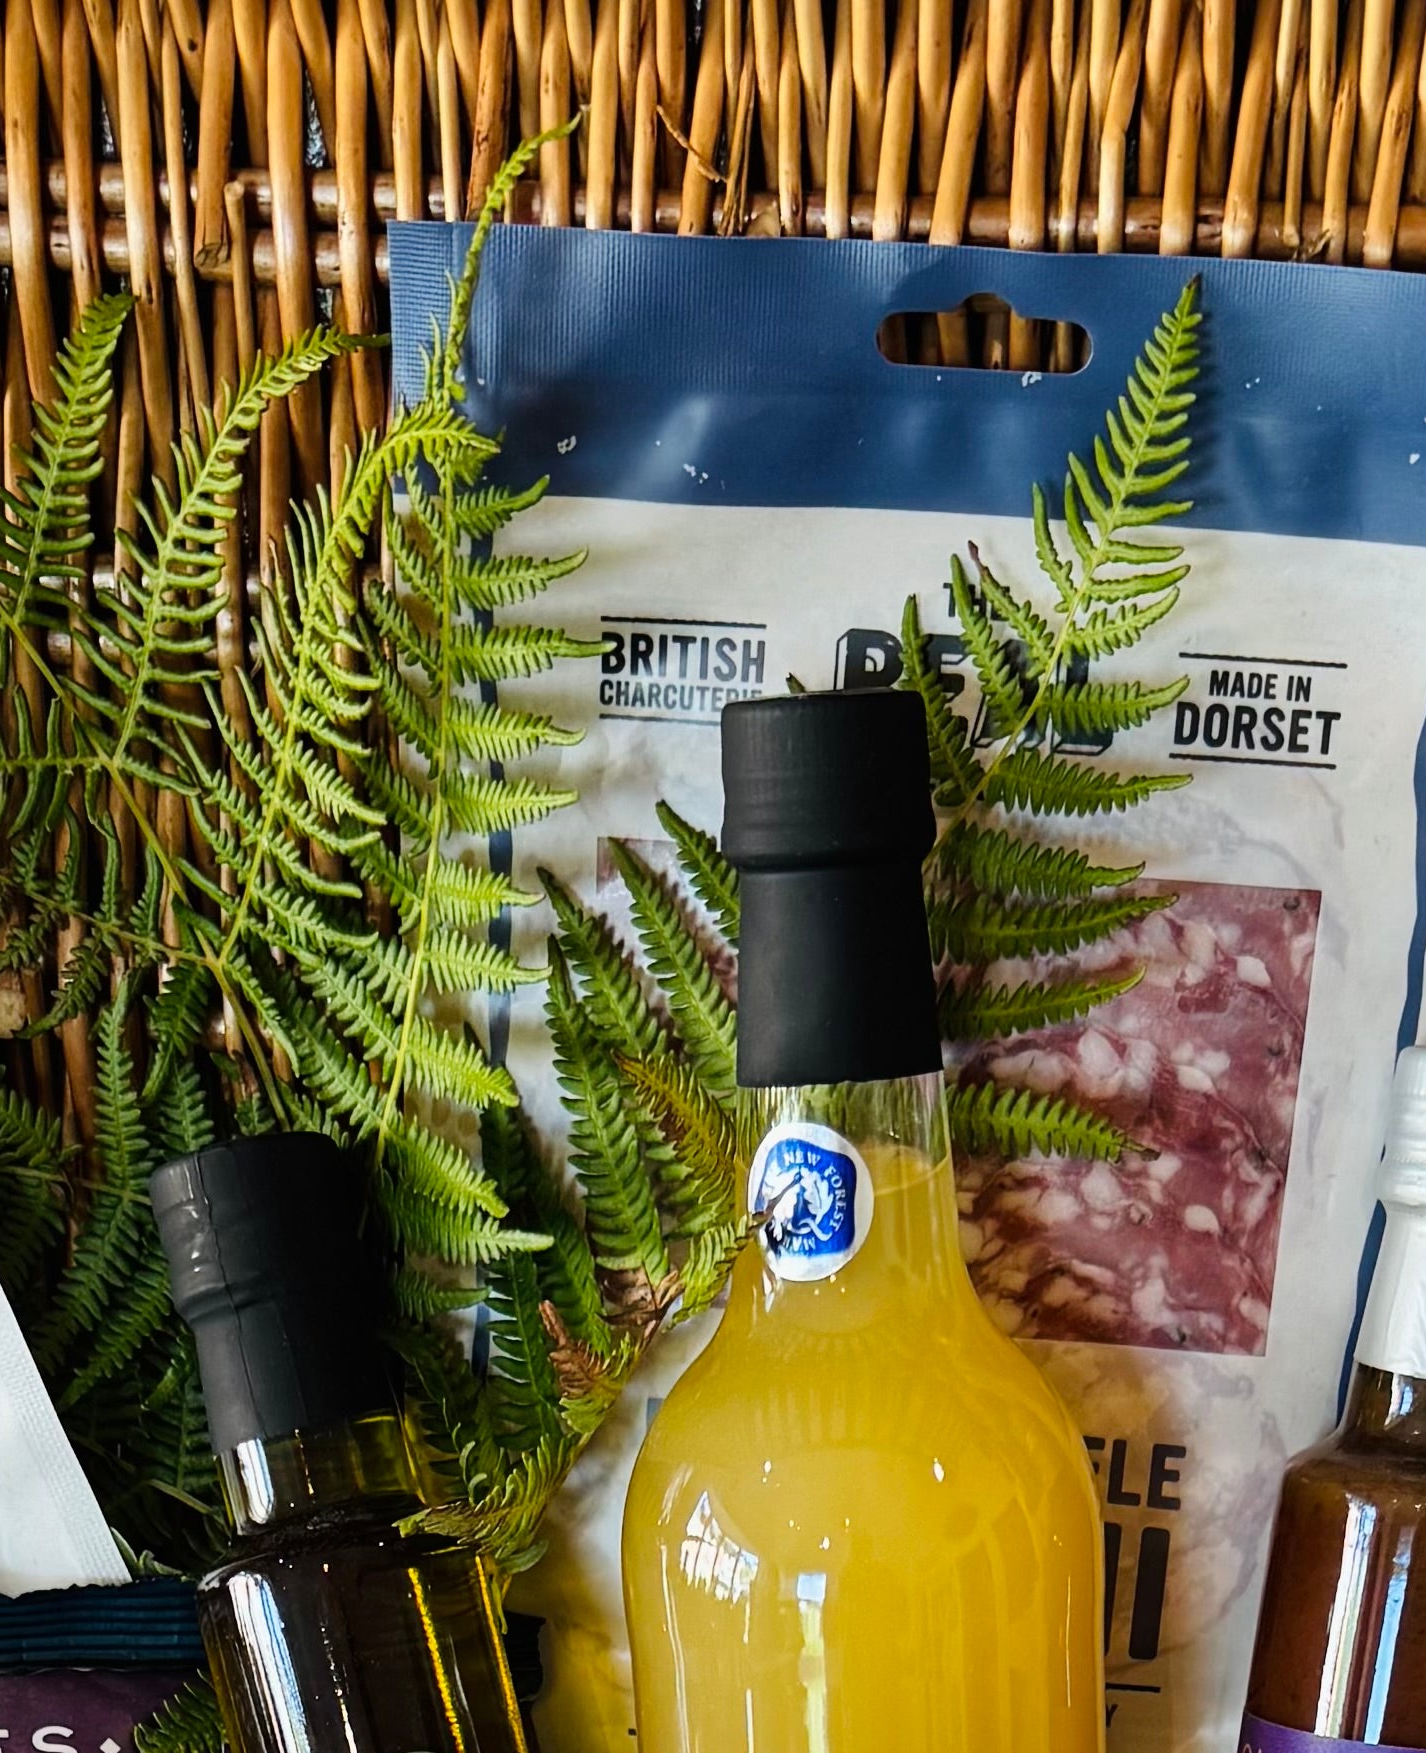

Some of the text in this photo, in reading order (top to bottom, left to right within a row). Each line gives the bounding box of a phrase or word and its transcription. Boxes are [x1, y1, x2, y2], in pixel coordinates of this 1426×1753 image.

[600, 631, 766, 684] BRITISH
[1209, 669, 1313, 702] MADE IN
[1173, 700, 1341, 756] DORSET
